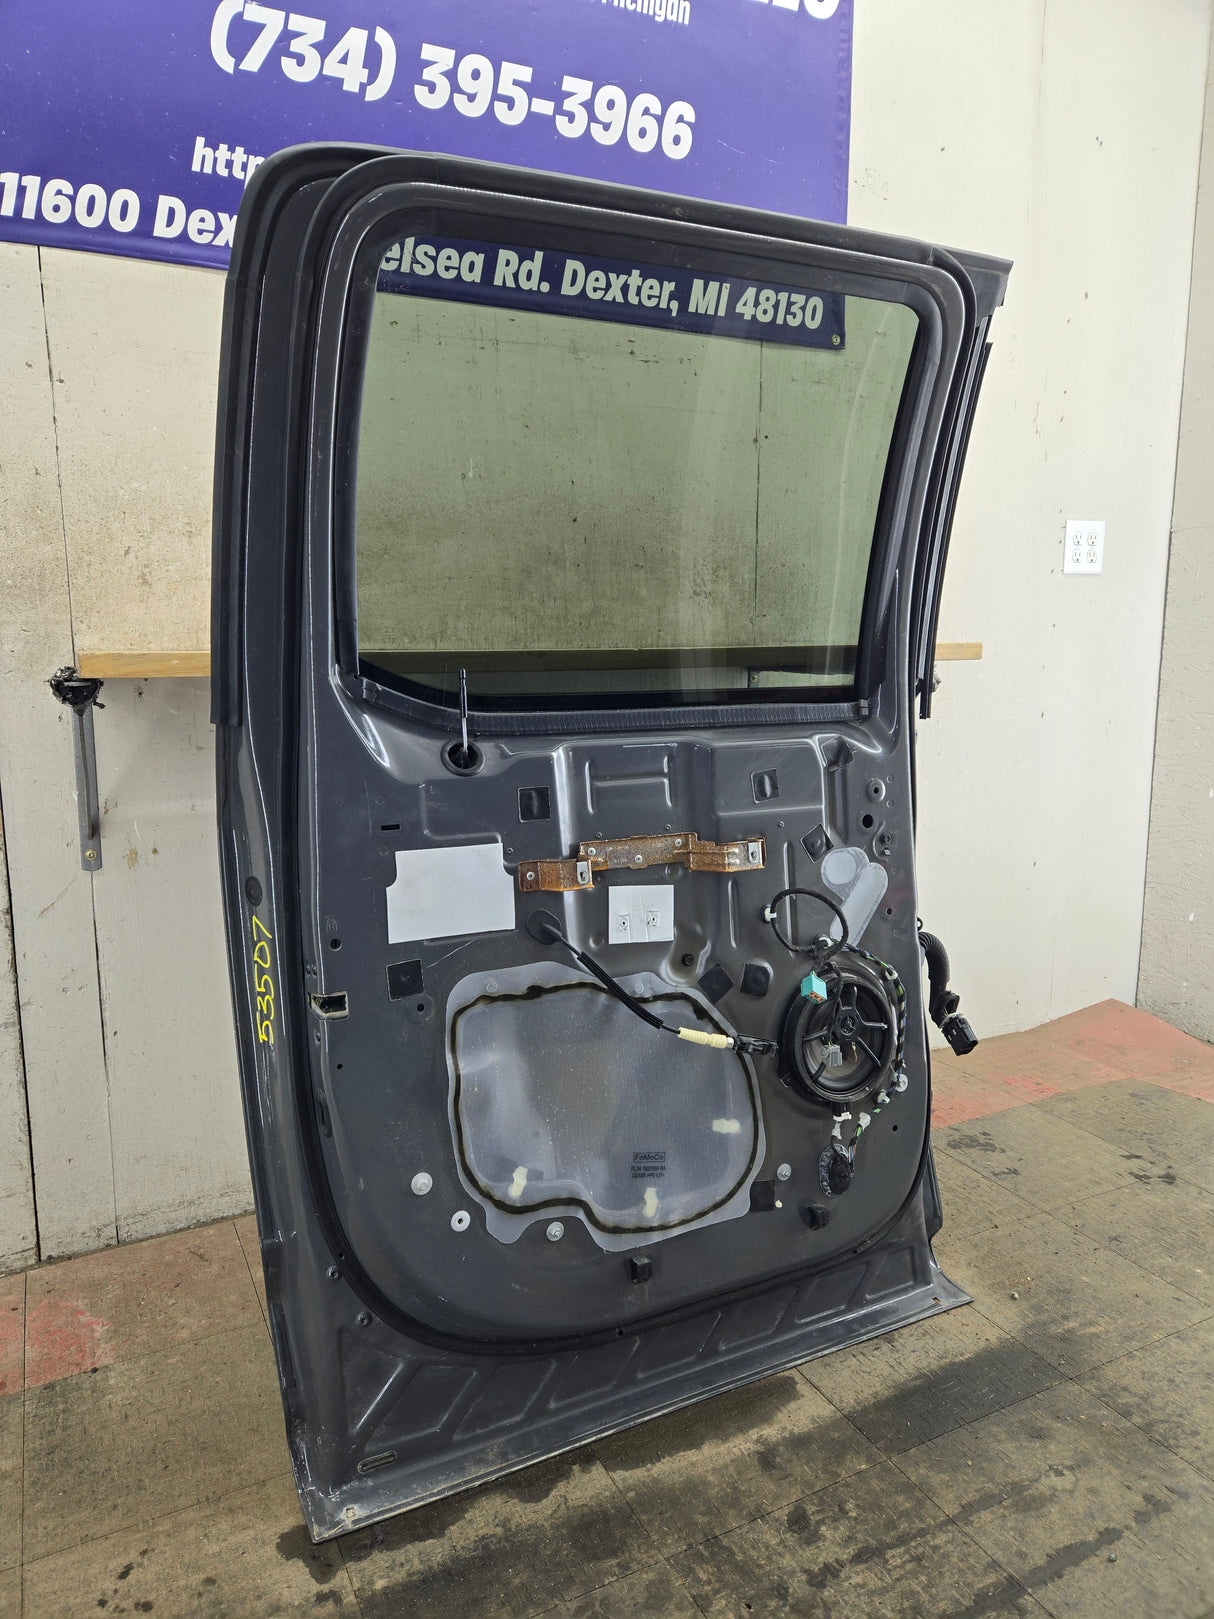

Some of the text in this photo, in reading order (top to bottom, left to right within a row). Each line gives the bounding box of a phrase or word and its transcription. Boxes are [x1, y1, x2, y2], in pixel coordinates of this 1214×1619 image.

[601, 0, 691, 25] igan
[210, 0, 696, 160] (734) 395-3966
[0, 171, 141, 233] 11600
[493, 248, 550, 293] Rd.
[560, 259, 679, 317] Dexter,
[688, 278, 731, 317] MI
[735, 286, 824, 330] 48130
[252, 915, 275, 1045] 53507
[633, 1153, 664, 1161] FoMoCo
